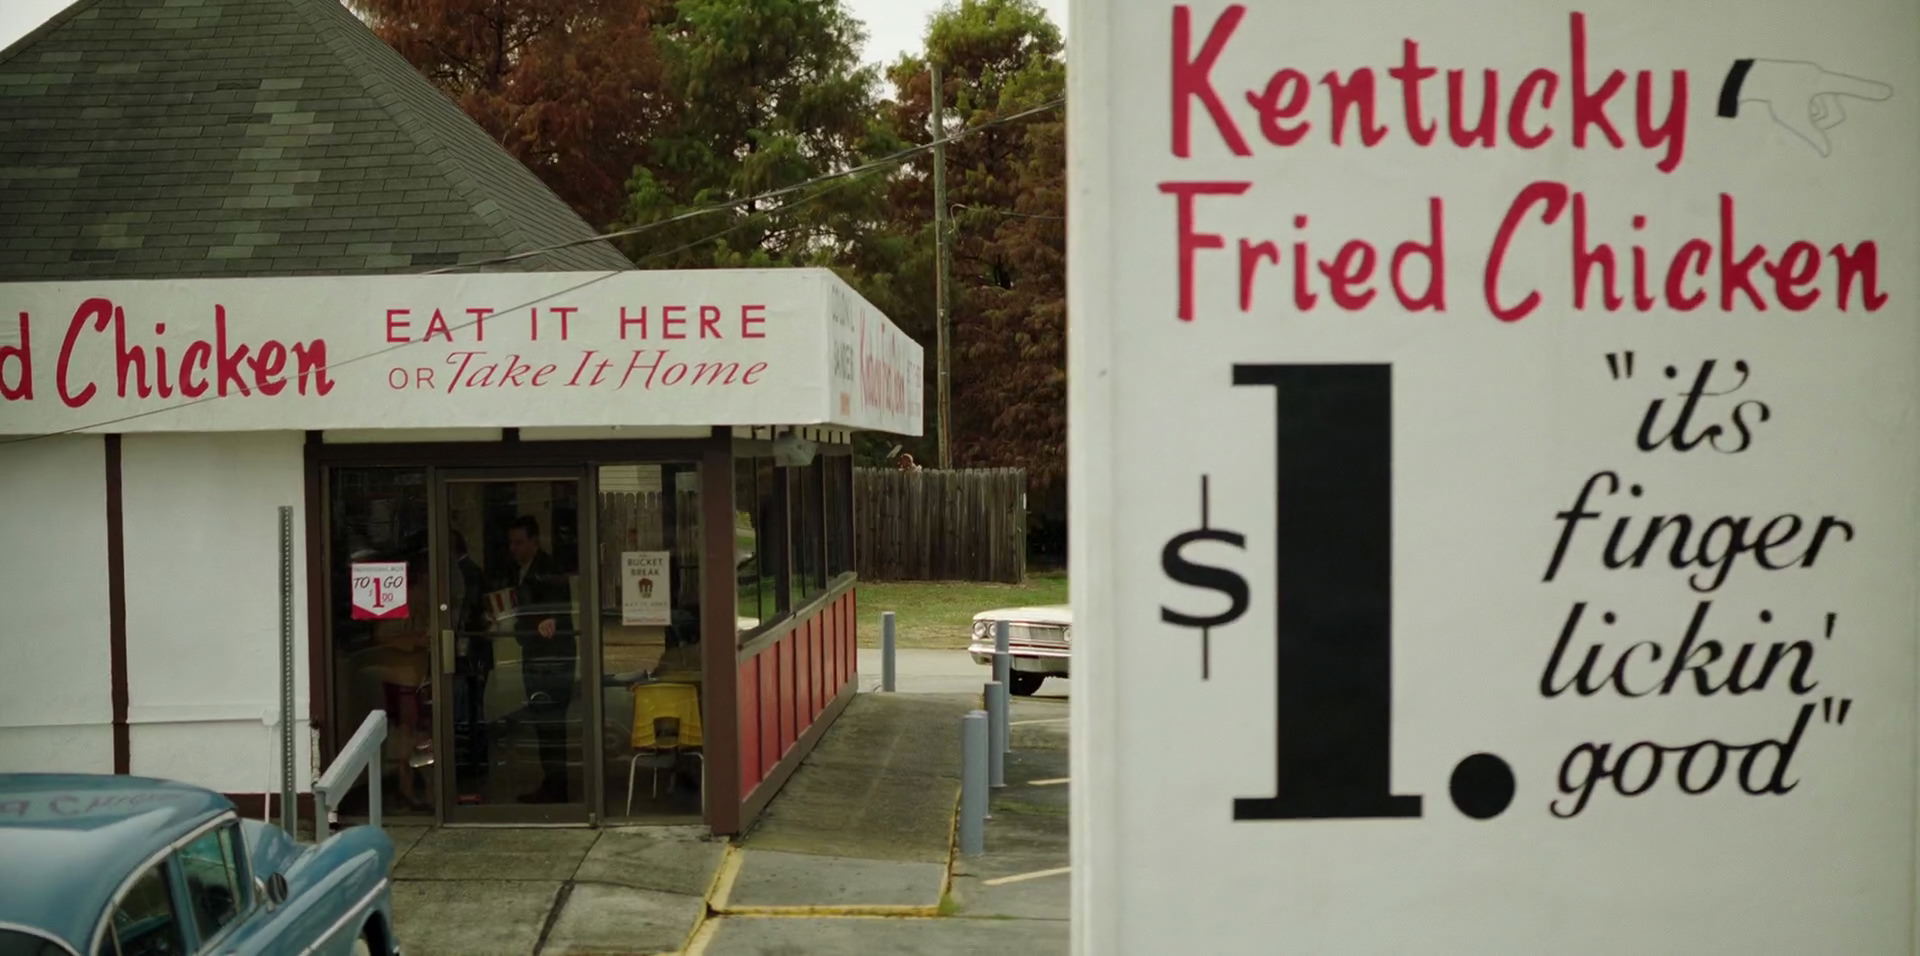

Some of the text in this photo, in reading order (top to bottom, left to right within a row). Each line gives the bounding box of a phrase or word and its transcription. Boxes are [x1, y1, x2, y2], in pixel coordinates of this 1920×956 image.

[1170, 3, 1690, 175] Kentucky
[1157, 181, 1890, 323] Fried Chicken
[55, 297, 335, 409] Chicken
[385, 304, 767, 343] EAT IT HERE
[388, 349, 769, 393] OR Take It Home
[627, 558, 664, 567] BUCKET
[630, 568, 660, 576] BREAK
[1540, 470, 1855, 594] finger
[353, 576, 404, 589] TO GO
[1539, 600, 1838, 699] lickin'
[1549, 696, 1854, 820] good"
